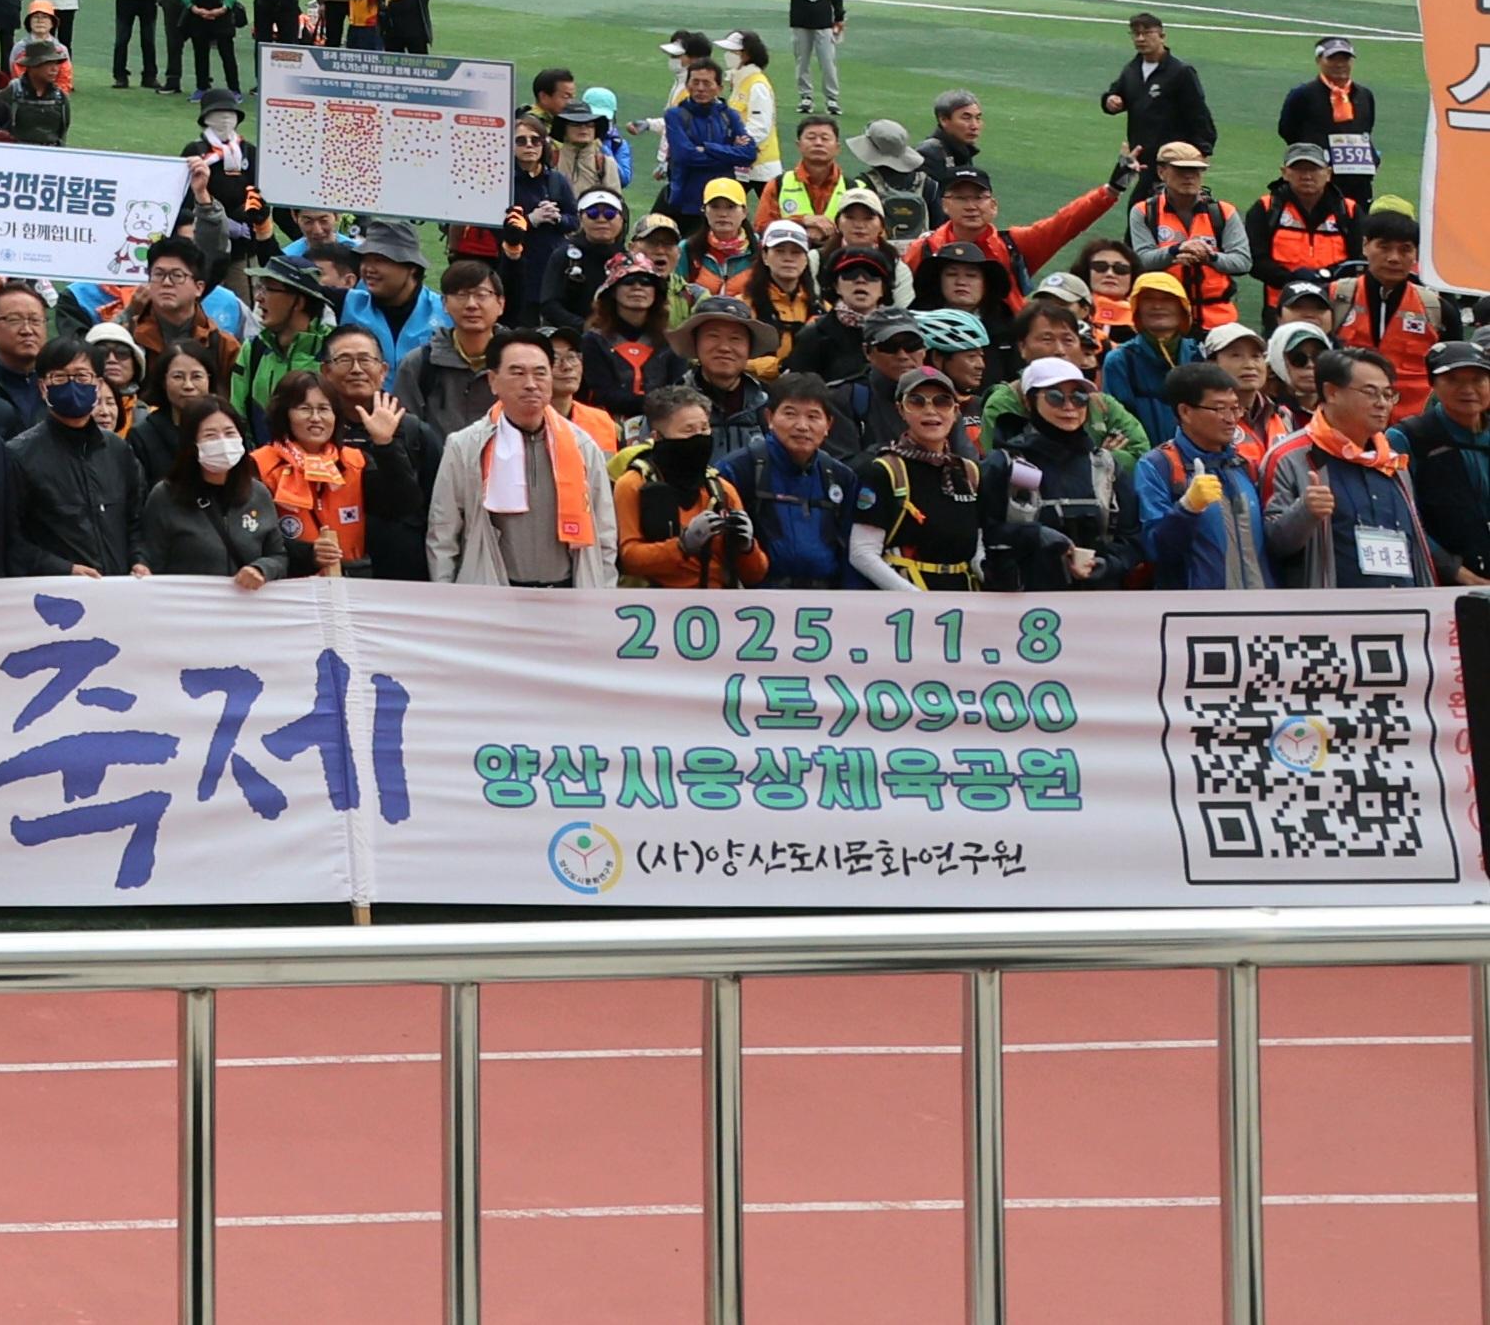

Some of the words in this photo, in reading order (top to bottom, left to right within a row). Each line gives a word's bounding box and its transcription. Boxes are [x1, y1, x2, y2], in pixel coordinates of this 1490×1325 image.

[1333, 147, 1374, 164] 3594
[22, 222, 98, 244] 함께합니다.
[614, 604, 1065, 664] 2025.11.8
[723, 672, 1079, 736] (토)09:00
[473, 743, 1084, 812] 양산시웅상체육공원
[637, 838, 1028, 879] (사)양산도시문화연구원
